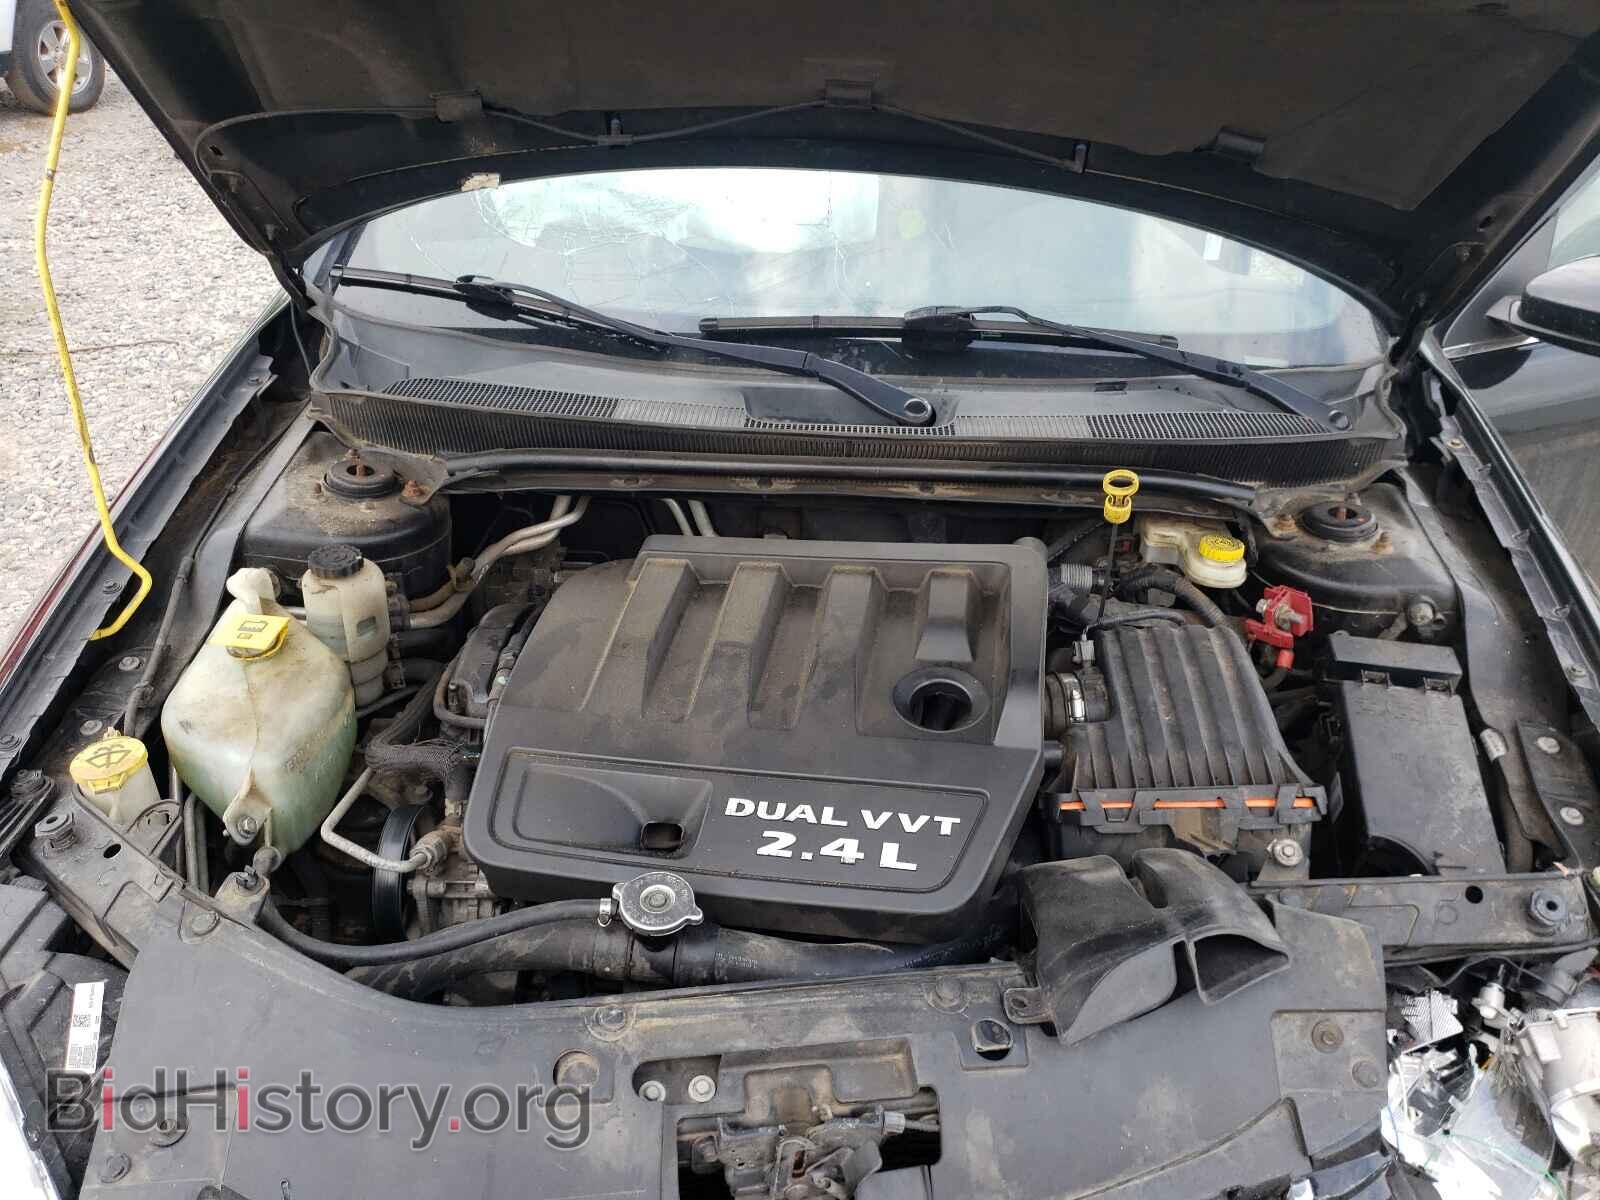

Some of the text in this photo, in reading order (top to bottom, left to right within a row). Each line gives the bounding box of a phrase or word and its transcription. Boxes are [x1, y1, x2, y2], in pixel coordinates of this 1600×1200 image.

[724, 797, 961, 836] DUAL VVT
[756, 830, 918, 871] 2.4 L
